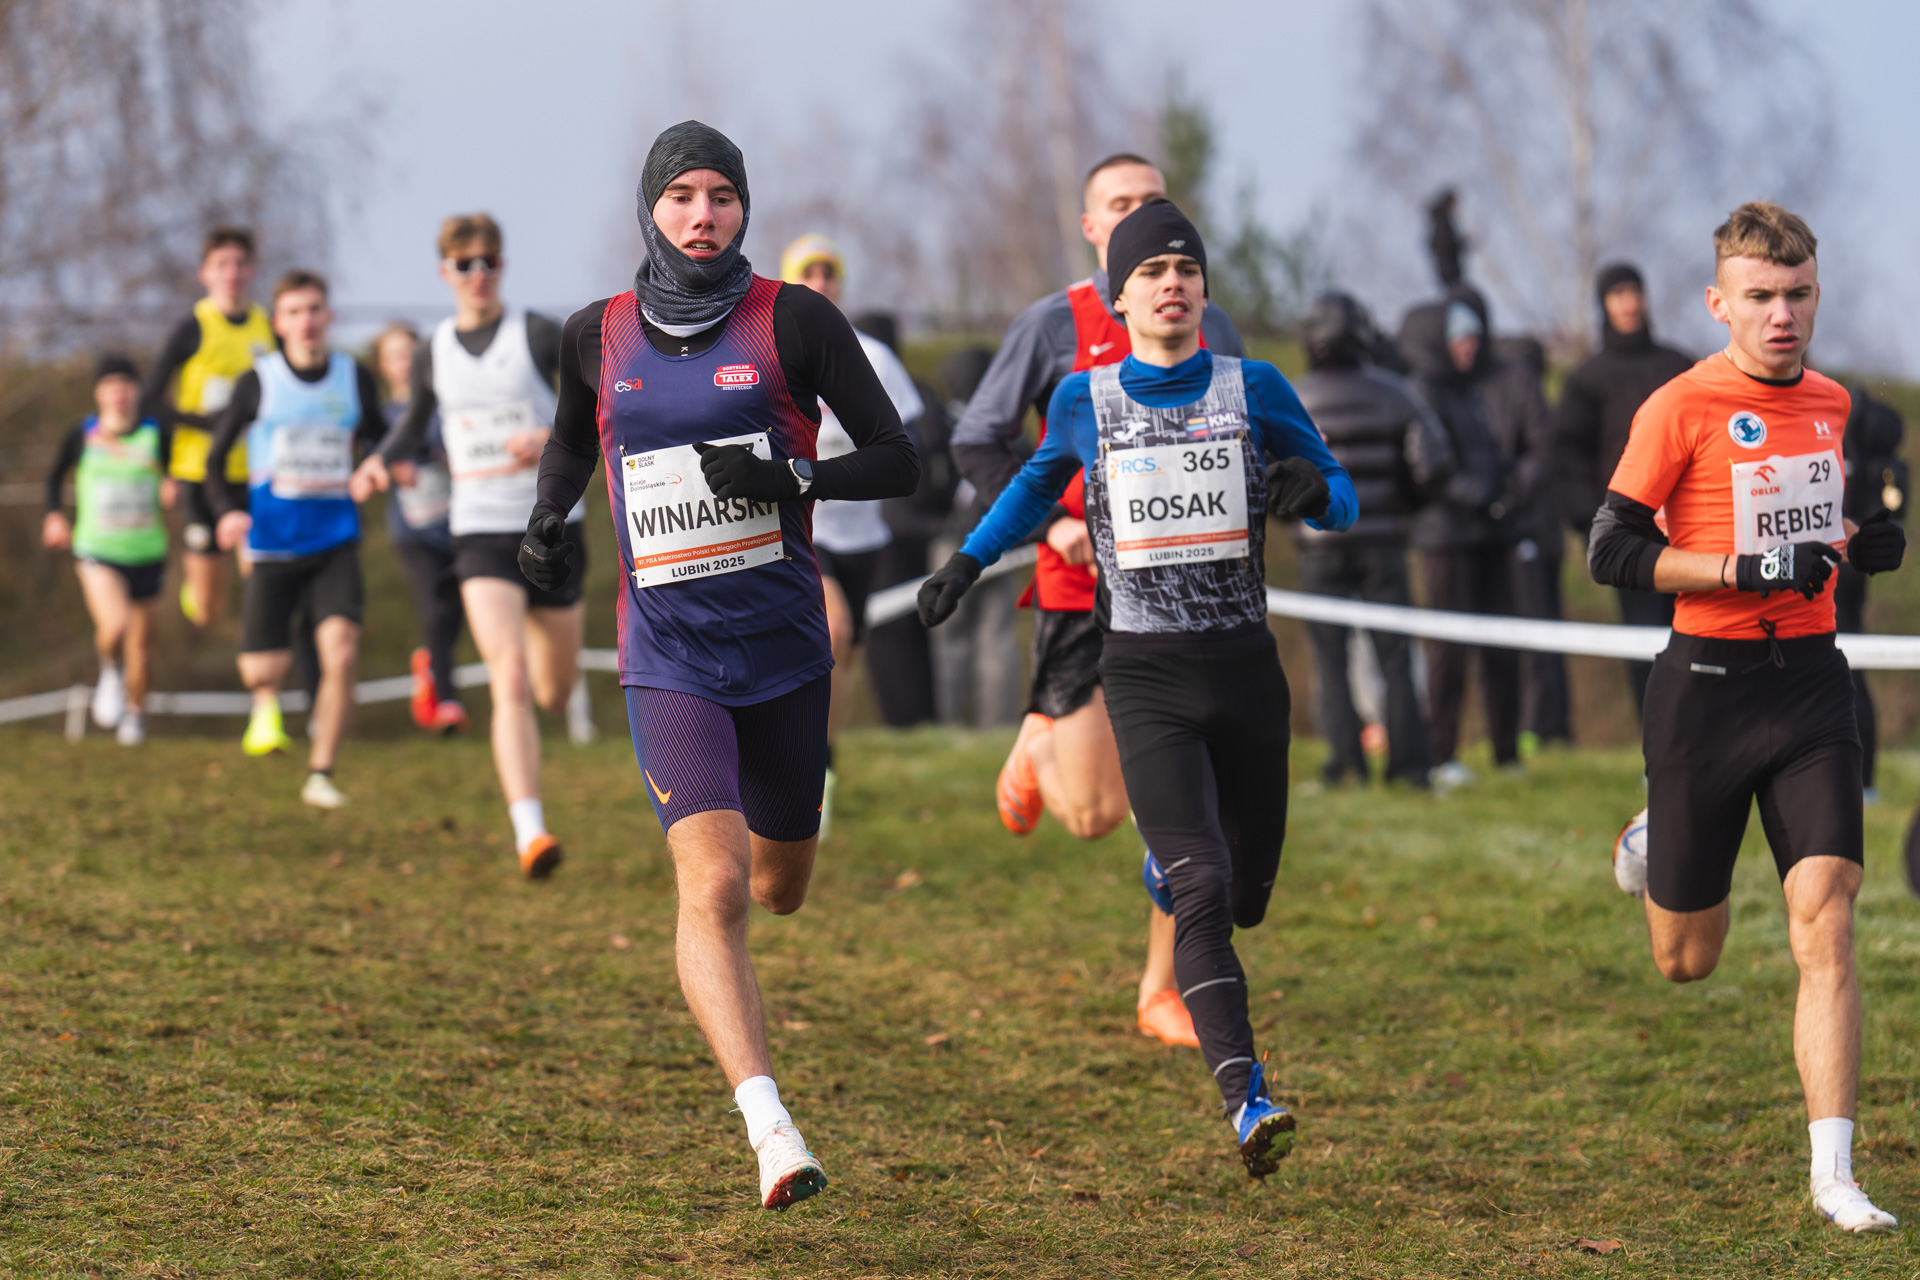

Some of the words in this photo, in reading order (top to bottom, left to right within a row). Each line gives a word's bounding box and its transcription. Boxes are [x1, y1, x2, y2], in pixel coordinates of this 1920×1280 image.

[615, 378, 643, 392] esa
[719, 373, 754, 383] TALEX
[1208, 412, 1241, 428] KML
[638, 455, 655, 463] DOLNY
[1183, 448, 1230, 473] 365
[1808, 459, 1830, 484] 29
[1751, 486, 1780, 497] ORLEN
[1129, 490, 1228, 524] BOSAK
[1757, 501, 1833, 540] RĘBISZ
[658, 552, 692, 562] Mistrzostwa
[692, 548, 710, 556] Polski
[716, 542, 742, 552] Biegach
[1150, 551, 1183, 561] LUBIN
[1186, 547, 1215, 558] 2025
[671, 562, 711, 577] LUBIN
[713, 555, 745, 570] 2025
